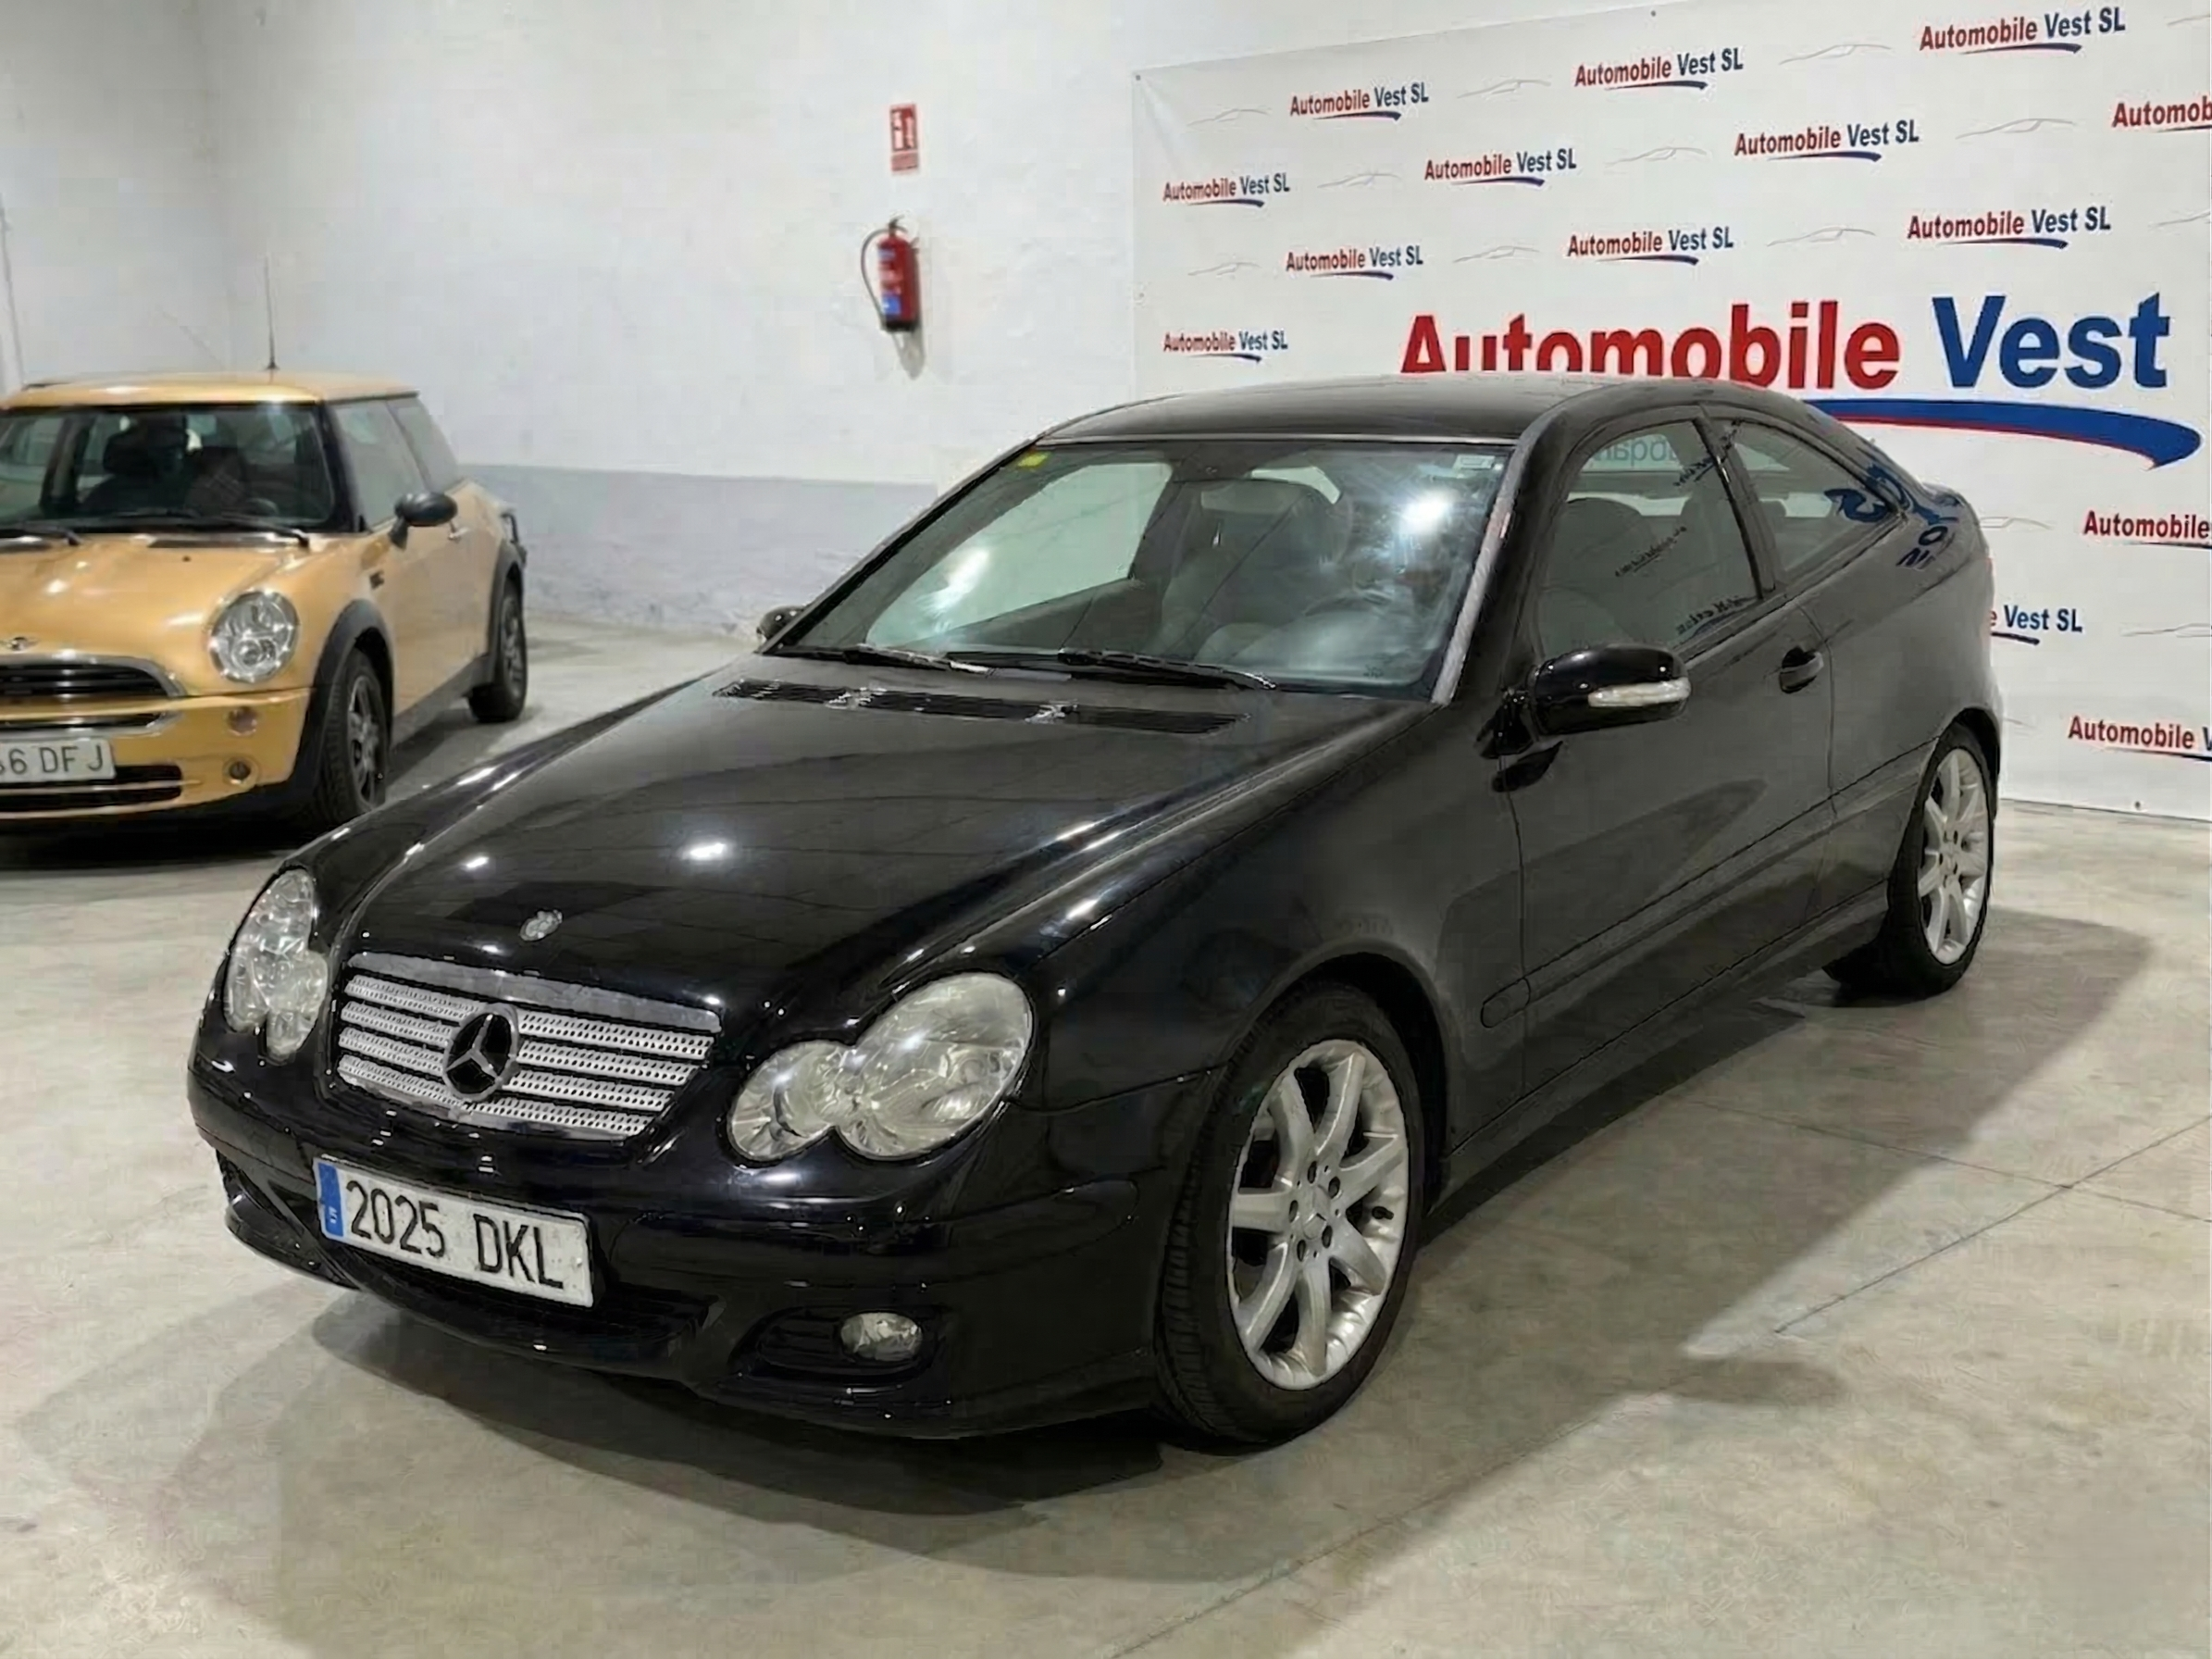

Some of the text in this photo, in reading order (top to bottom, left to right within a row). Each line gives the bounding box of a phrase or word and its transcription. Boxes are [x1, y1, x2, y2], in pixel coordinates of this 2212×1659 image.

[1920, 7, 2126, 50] Automobile Vest SL
[1575, 48, 1744, 87] Automobile Vest SL
[1290, 81, 1429, 117] Automobile Vest SL
[1734, 120, 1920, 156] Automobile Vest SL
[1425, 147, 1577, 181] Automobile Vest SL
[1163, 172, 1289, 202] Automobile Vest SL
[1908, 206, 2111, 239] Automobile Vest SL
[1286, 243, 1423, 271] Automobile Vest SL
[1568, 227, 1734, 256] Automobile Vest SL
[1163, 330, 1288, 352] Automobile Vest SL
[1400, 292, 2170, 389] Automobile Vest
[2083, 511, 2209, 539] Automobile
[2004, 605, 2051, 630] Vest
[2057, 609, 2082, 632] SL
[2068, 716, 2193, 749] Automobile
[39, 744, 104, 774] DFJ
[346, 1179, 565, 1291] 2025 DKL
